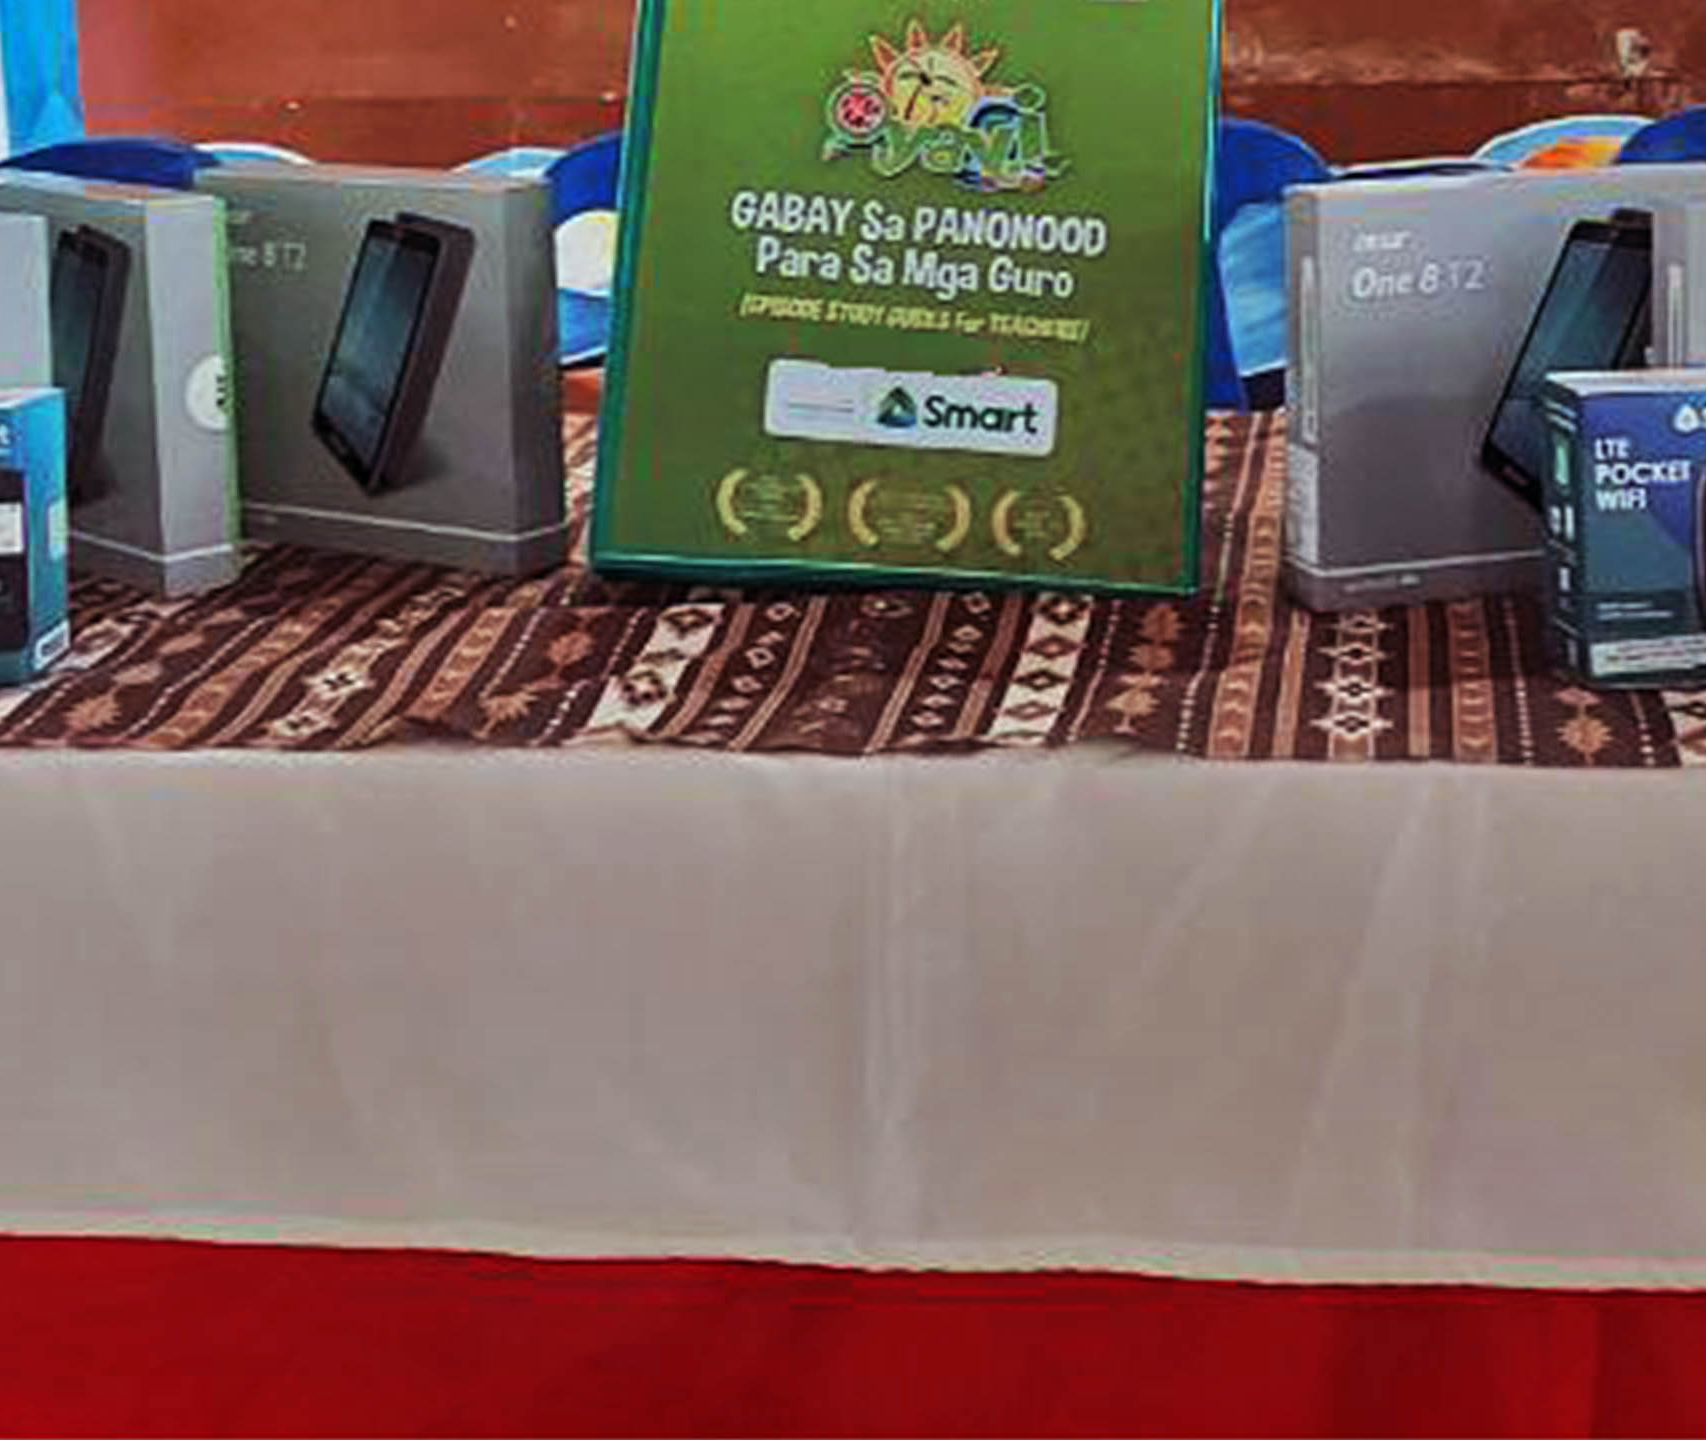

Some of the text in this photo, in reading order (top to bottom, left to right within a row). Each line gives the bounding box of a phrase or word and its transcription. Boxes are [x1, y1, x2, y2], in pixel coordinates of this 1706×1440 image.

[731, 191, 1107, 256] GABAY Sa PANONOOD
[756, 235, 1074, 301] Para Sa Mga Guro
[1352, 266, 1414, 298] One
[1419, 262, 1440, 294] 8
[924, 395, 1038, 433] Smart
[1594, 437, 1630, 460] LTE
[1594, 460, 1691, 485] POCKET
